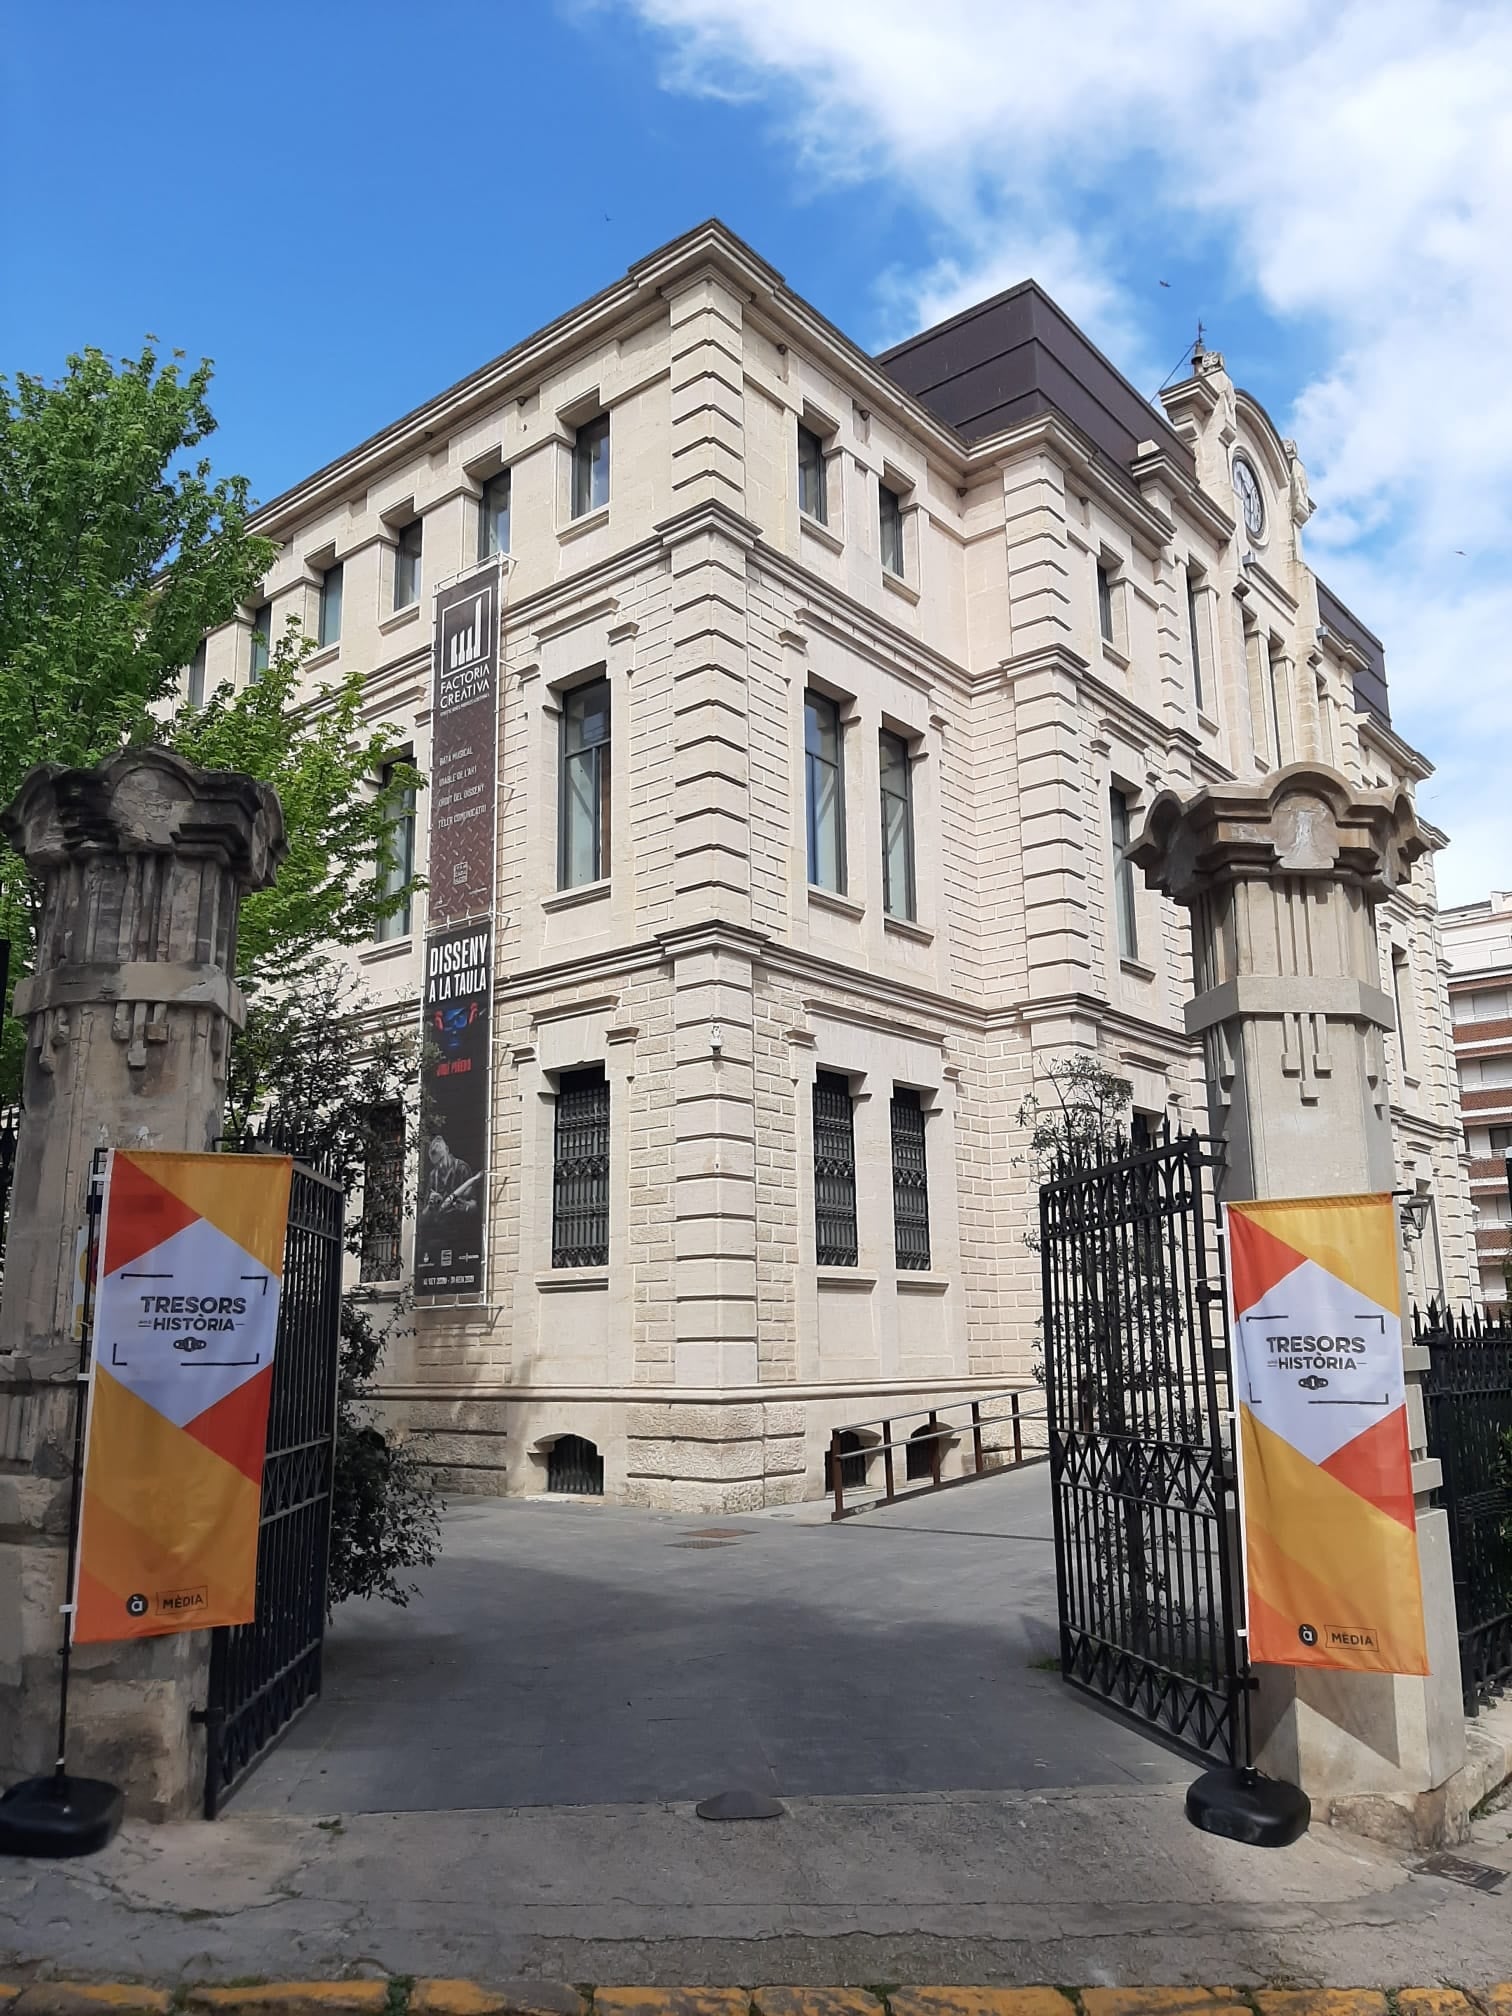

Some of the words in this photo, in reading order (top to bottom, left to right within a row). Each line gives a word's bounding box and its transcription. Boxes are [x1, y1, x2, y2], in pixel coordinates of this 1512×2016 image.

[440, 663, 490, 694] FACTORIA
[440, 678, 490, 708] CREATIVA
[430, 933, 488, 977] DISSENY
[428, 979, 436, 1003] A
[439, 975, 451, 1001] LA
[453, 967, 487, 997] TAULA
[140, 1295, 247, 1315] TRESORS
[153, 1313, 236, 1331] HISTÒRIA
[1265, 1335, 1366, 1354] TRESORS
[1278, 1352, 1358, 1370] HISTÒRIA
